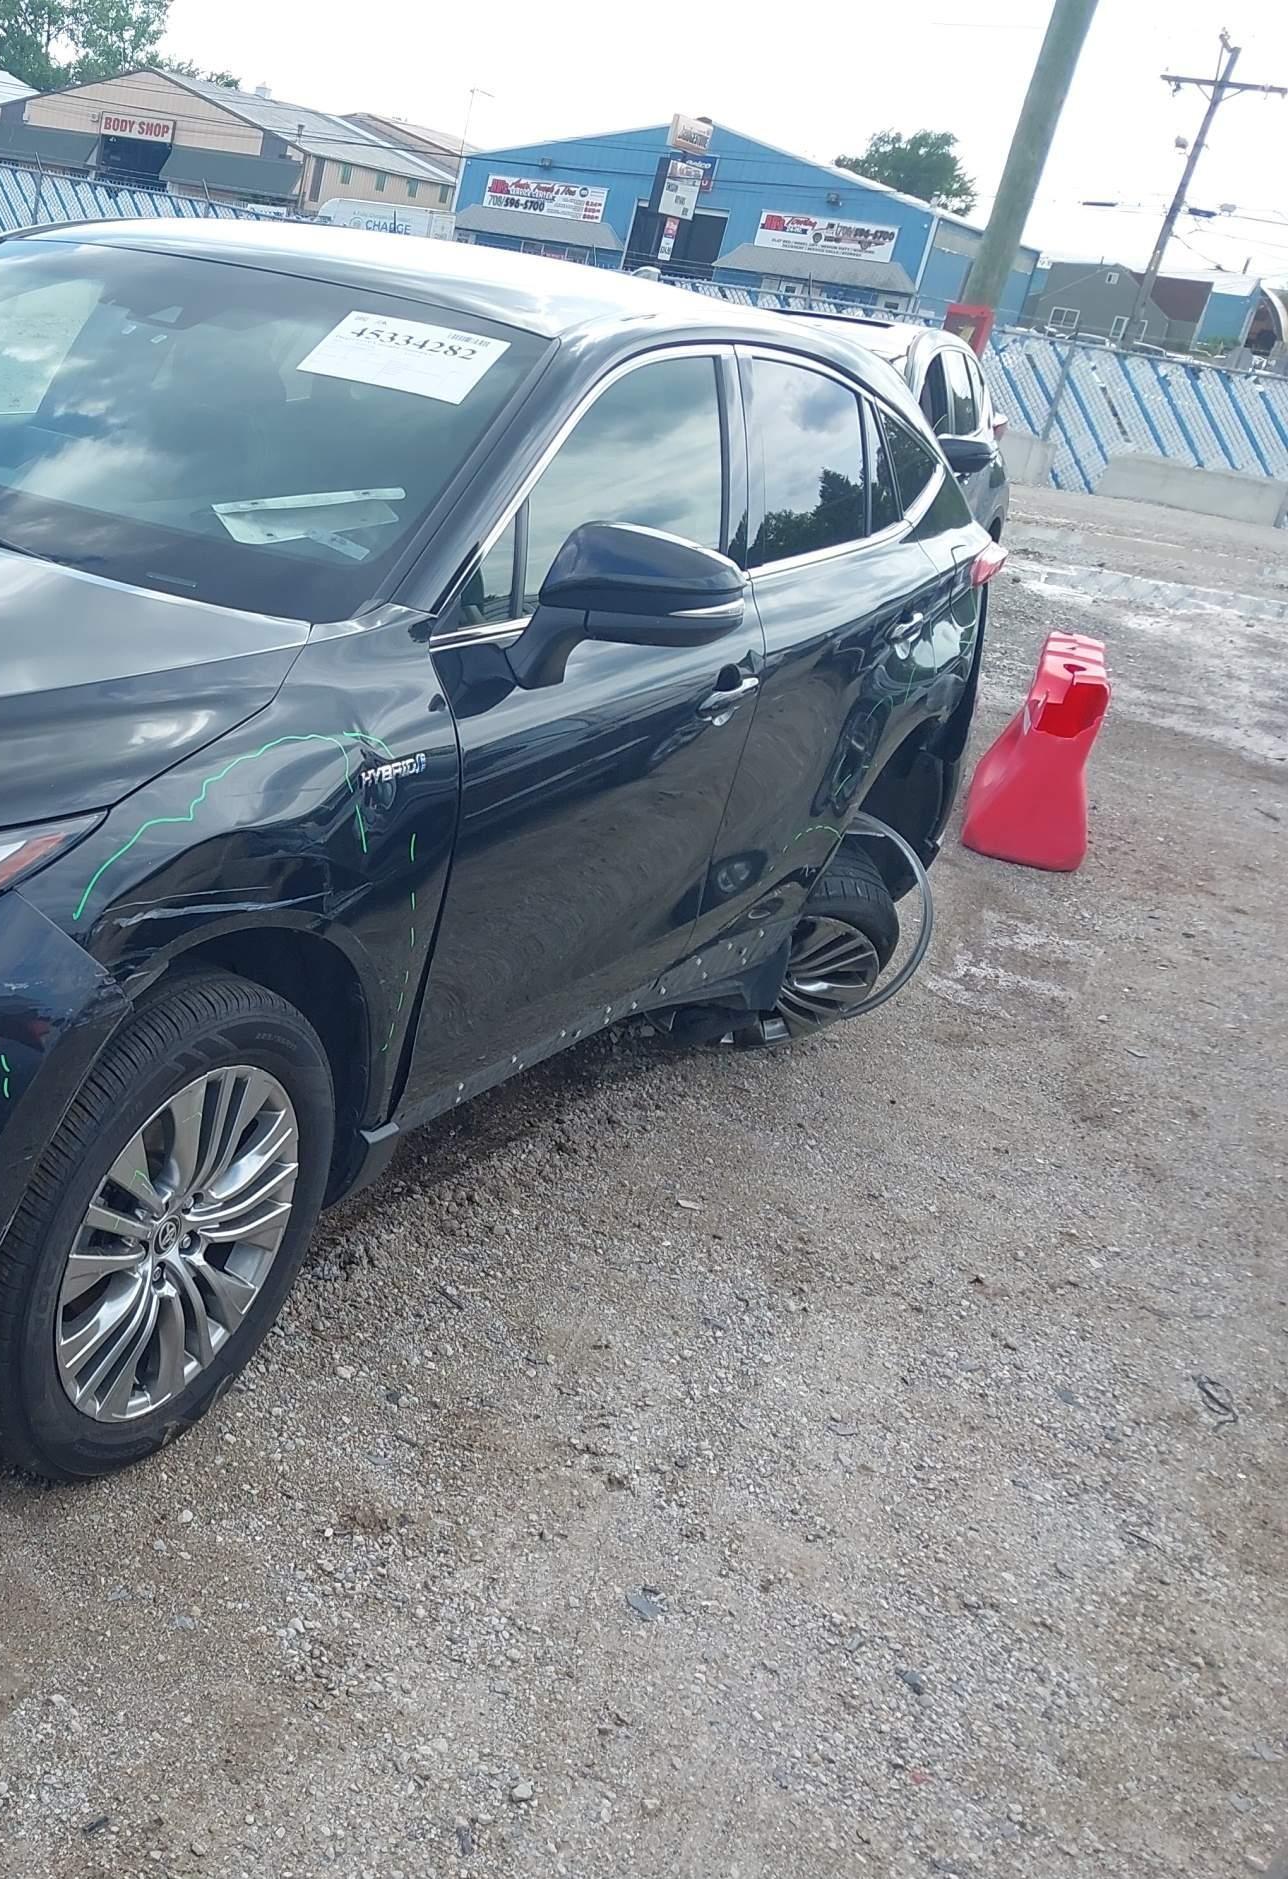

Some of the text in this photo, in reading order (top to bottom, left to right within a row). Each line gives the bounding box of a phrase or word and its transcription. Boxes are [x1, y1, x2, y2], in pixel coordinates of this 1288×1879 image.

[104, 117, 170, 138] BODY SHOP
[350, 327, 479, 361] 45334282
[360, 758, 416, 786] HYBRID
